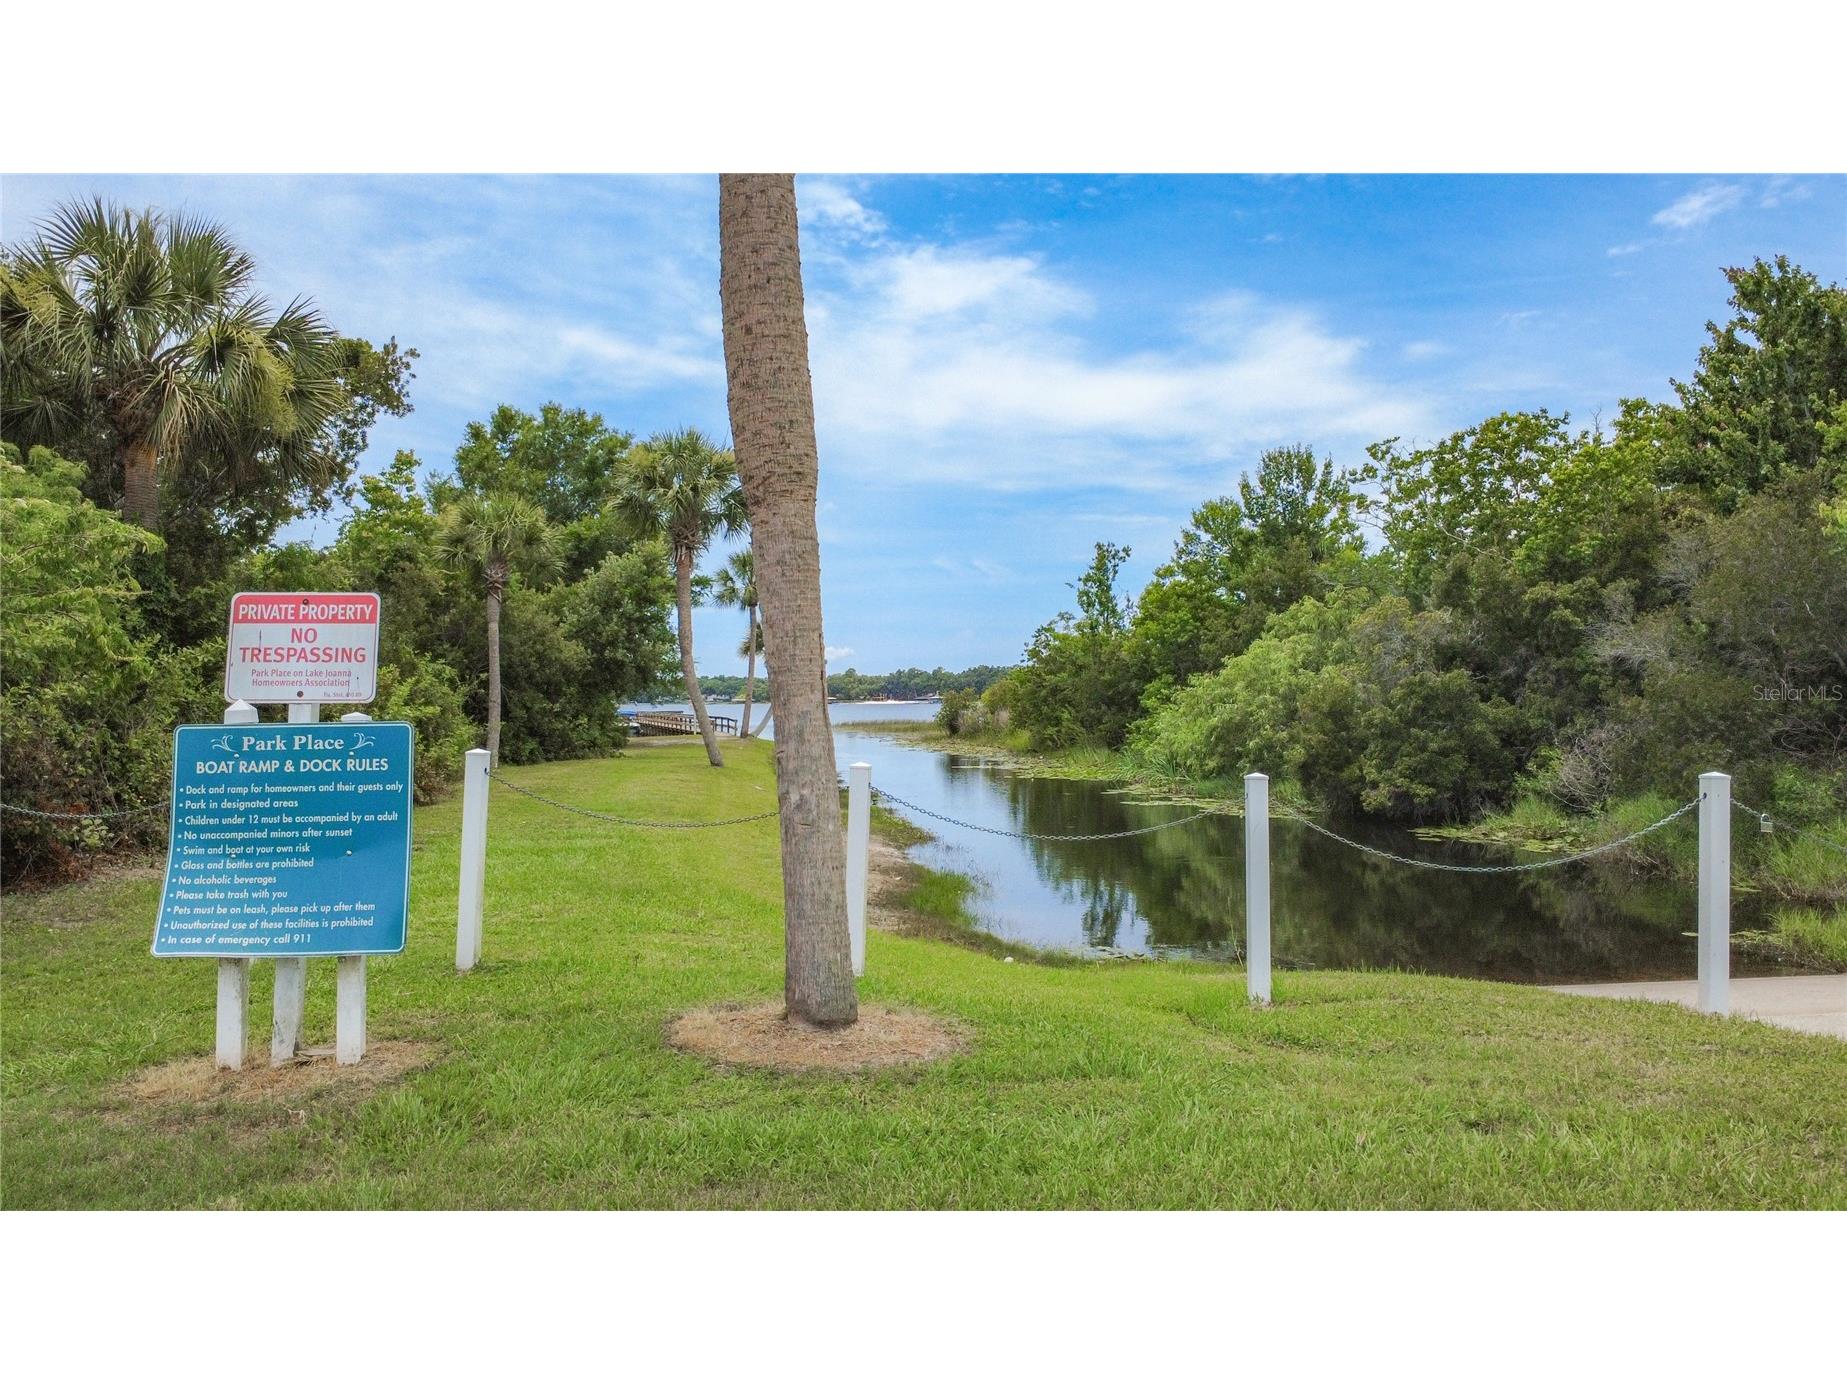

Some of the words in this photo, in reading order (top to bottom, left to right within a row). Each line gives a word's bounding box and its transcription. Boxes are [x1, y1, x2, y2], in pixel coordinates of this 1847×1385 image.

[238, 604, 296, 620] PRIVATE
[300, 604, 373, 620] PROPERTY
[290, 627, 318, 644] NO
[239, 646, 366, 663] TRESPASSING
[251, 669, 269, 677] Park
[271, 669, 292, 677] Place
[305, 669, 323, 677] Lake
[325, 669, 352, 678] Joanna
[252, 678, 303, 687] Homeowners
[304, 678, 350, 687] Association
[242, 735, 287, 751] Park
[293, 734, 345, 750] Place
[196, 761, 235, 774] BOAT
[239, 760, 280, 774] RAMP
[284, 760, 295, 772] &
[300, 759, 342, 772] DOCK
[346, 758, 389, 772] RULES
[185, 784, 207, 794] Dock
[208, 784, 225, 794] and
[227, 786, 249, 796] ramp
[250, 783, 262, 793] for
[265, 783, 316, 793] homeowners
[318, 782, 335, 792] and
[336, 781, 355, 791] their
[357, 782, 383, 793] guests
[385, 780, 404, 793] only
[185, 799, 206, 809] Park
[209, 800, 218, 809] in
[221, 798, 270, 811] designated
[272, 800, 298, 808] areas
[184, 815, 219, 825] Children
[221, 815, 246, 825] under
[248, 815, 259, 824] 12
[261, 815, 280, 823] must
[282, 813, 293, 823] be
[295, 812, 349, 824] accompanied
[351, 812, 362, 824] by
[377, 811, 399, 821] adult
[183, 831, 197, 840] No
[199, 828, 268, 841] unaccompanied
[270, 828, 300, 838] minors
[302, 827, 323, 837] after
[325, 828, 353, 837] sunset
[183, 845, 205, 855] Swim
[207, 845, 224, 855] and
[225, 844, 244, 854] boat
[245, 846, 254, 854] at
[256, 846, 274, 856] your
[276, 845, 293, 853] own
[295, 842, 311, 852] risk
[181, 860, 204, 870] Glass
[207, 860, 224, 869] and
[226, 859, 253, 869] bottles
[271, 857, 315, 870] prohibited
[178, 876, 192, 885] No
[193, 874, 232, 884] alcoholic
[233, 874, 277, 886] beverages
[175, 890, 204, 900] Please
[206, 889, 225, 899] take
[227, 889, 249, 899] trash
[251, 888, 270, 898] with
[272, 891, 288, 900] you
[173, 905, 191, 915] Pets
[193, 906, 215, 914] must
[216, 904, 228, 914] be
[230, 906, 241, 914] on
[243, 904, 269, 915] leash,
[271, 903, 298, 915] please
[300, 902, 318, 915] pick
[320, 905, 331, 914] up
[333, 901, 353, 911] after
[355, 901, 376, 911] them
[170, 919, 230, 930] Unauthorized
[232, 921, 247, 929] use
[249, 919, 260, 929] of
[260, 919, 283, 929] these
[285, 918, 320, 928] facilities
[321, 919, 329, 928] is
[330, 916, 374, 930] prohibited
[167, 935, 177, 944] In
[180, 936, 203, 944] case
[205, 934, 217, 944] of
[218, 936, 272, 946] emergency
[273, 934, 291, 944] call
[293, 934, 311, 943] 911
